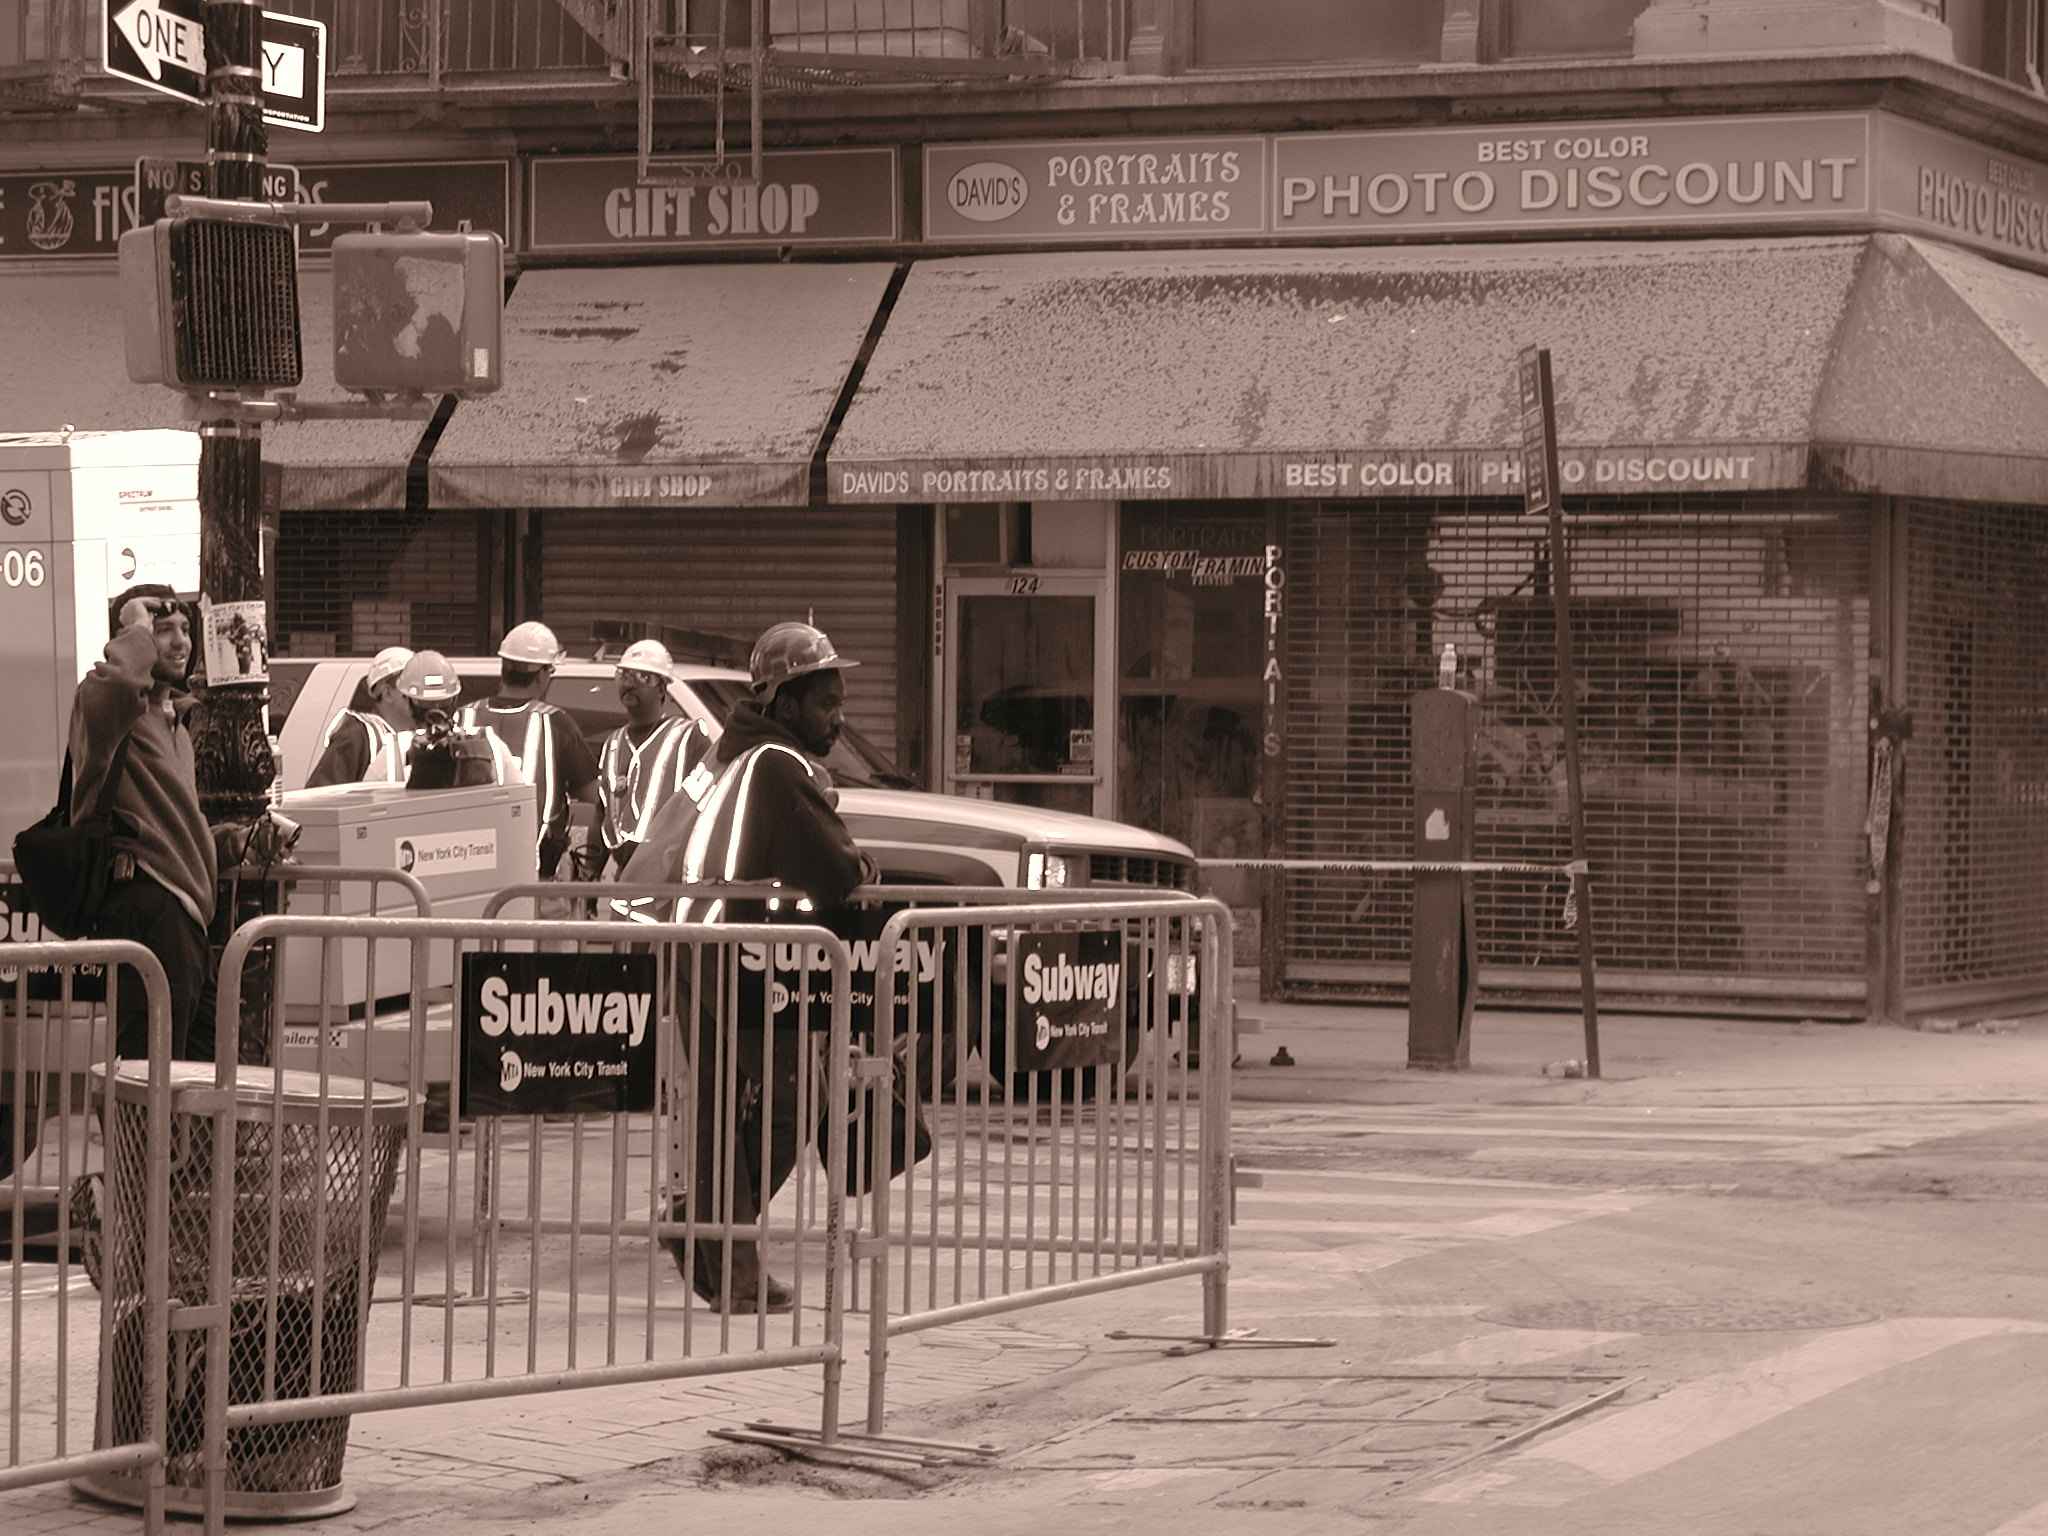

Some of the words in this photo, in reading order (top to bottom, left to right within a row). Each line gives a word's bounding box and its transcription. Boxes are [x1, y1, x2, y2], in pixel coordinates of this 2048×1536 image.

[136, 9, 189, 63] ONE
[1478, 140, 1546, 163] BEST
[1554, 135, 1649, 160] COLOR
[1047, 151, 1241, 187] PORTRAITS
[956, 176, 1021, 207] DAVID'S
[1282, 170, 1496, 218] PHOTO
[1520, 157, 1858, 210] DISCOUNT
[1918, 165, 1988, 236] PHOTO
[604, 186, 695, 240] GIFT
[707, 183, 820, 235] SHOP
[1056, 196, 1076, 226] &
[1088, 190, 1232, 225] FRAMES
[658, 475, 713, 498] SHOP
[842, 470, 909, 495] DAVID'S
[922, 468, 1049, 494] PORTRAITS
[1054, 466, 1070, 491] &
[1075, 466, 1173, 491] FRAMES
[1286, 463, 1352, 487] BEST
[1361, 461, 1453, 486] COLOR
[1481, 460, 1585, 485] PHO
[1595, 456, 1755, 483] DISCOUNT
[1124, 550, 1198, 571] CUSTOM
[1011, 576, 1039, 594] 124
[418, 848, 434, 862] New
[436, 846, 452, 860] York
[452, 844, 468, 861] City
[468, 842, 495, 857] Transit
[80, 962, 104, 977] City
[1023, 953, 1120, 1010] Subway
[479, 976, 652, 1047] Subway
[850, 991, 873, 1006] City
[524, 1062, 546, 1078] New
[549, 1062, 571, 1077] York
[574, 1061, 594, 1079] City
[597, 1060, 628, 1076] Transit
